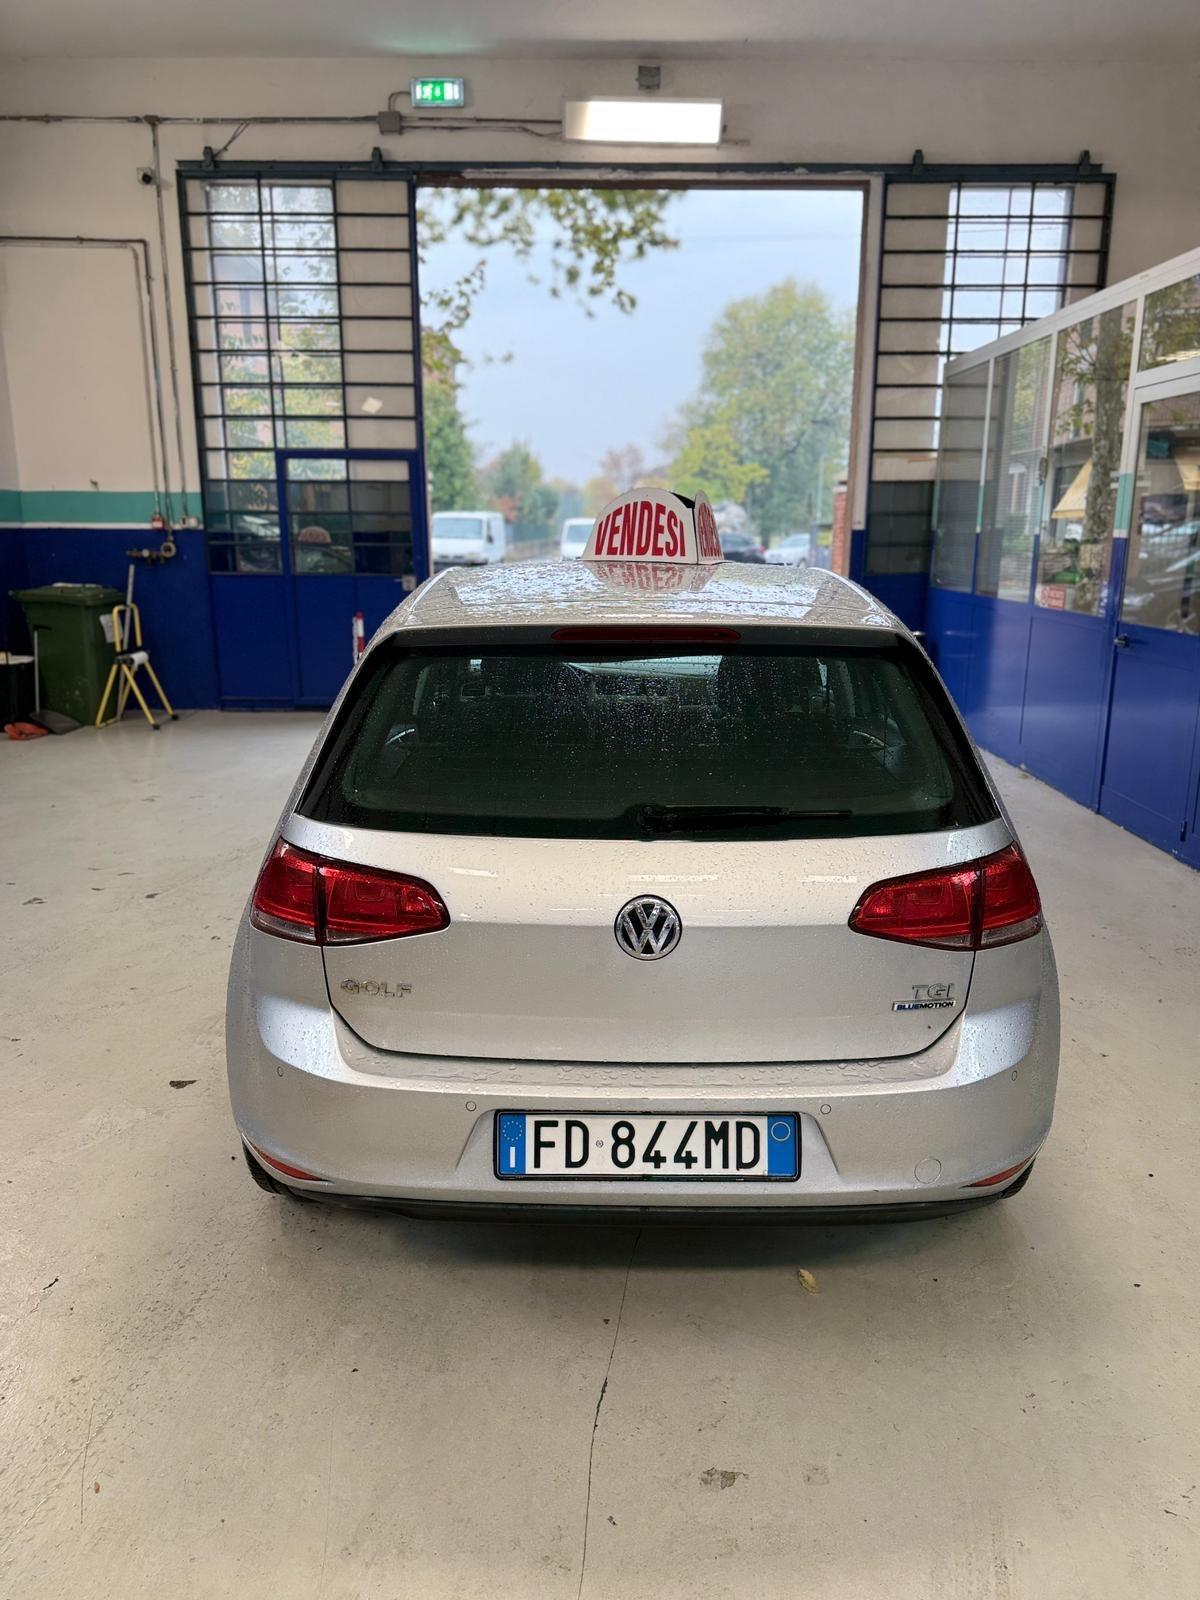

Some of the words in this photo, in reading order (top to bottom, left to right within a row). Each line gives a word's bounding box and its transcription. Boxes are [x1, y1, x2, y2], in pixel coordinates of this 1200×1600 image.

[594, 500, 686, 557] VENDESI
[618, 900, 678, 956] VW
[340, 978, 412, 997] GOLF
[912, 983, 955, 999] TGI
[896, 1001, 954, 1011] BLUEMOTION
[533, 1120, 590, 1169] FD
[611, 1120, 761, 1169] 844MD
